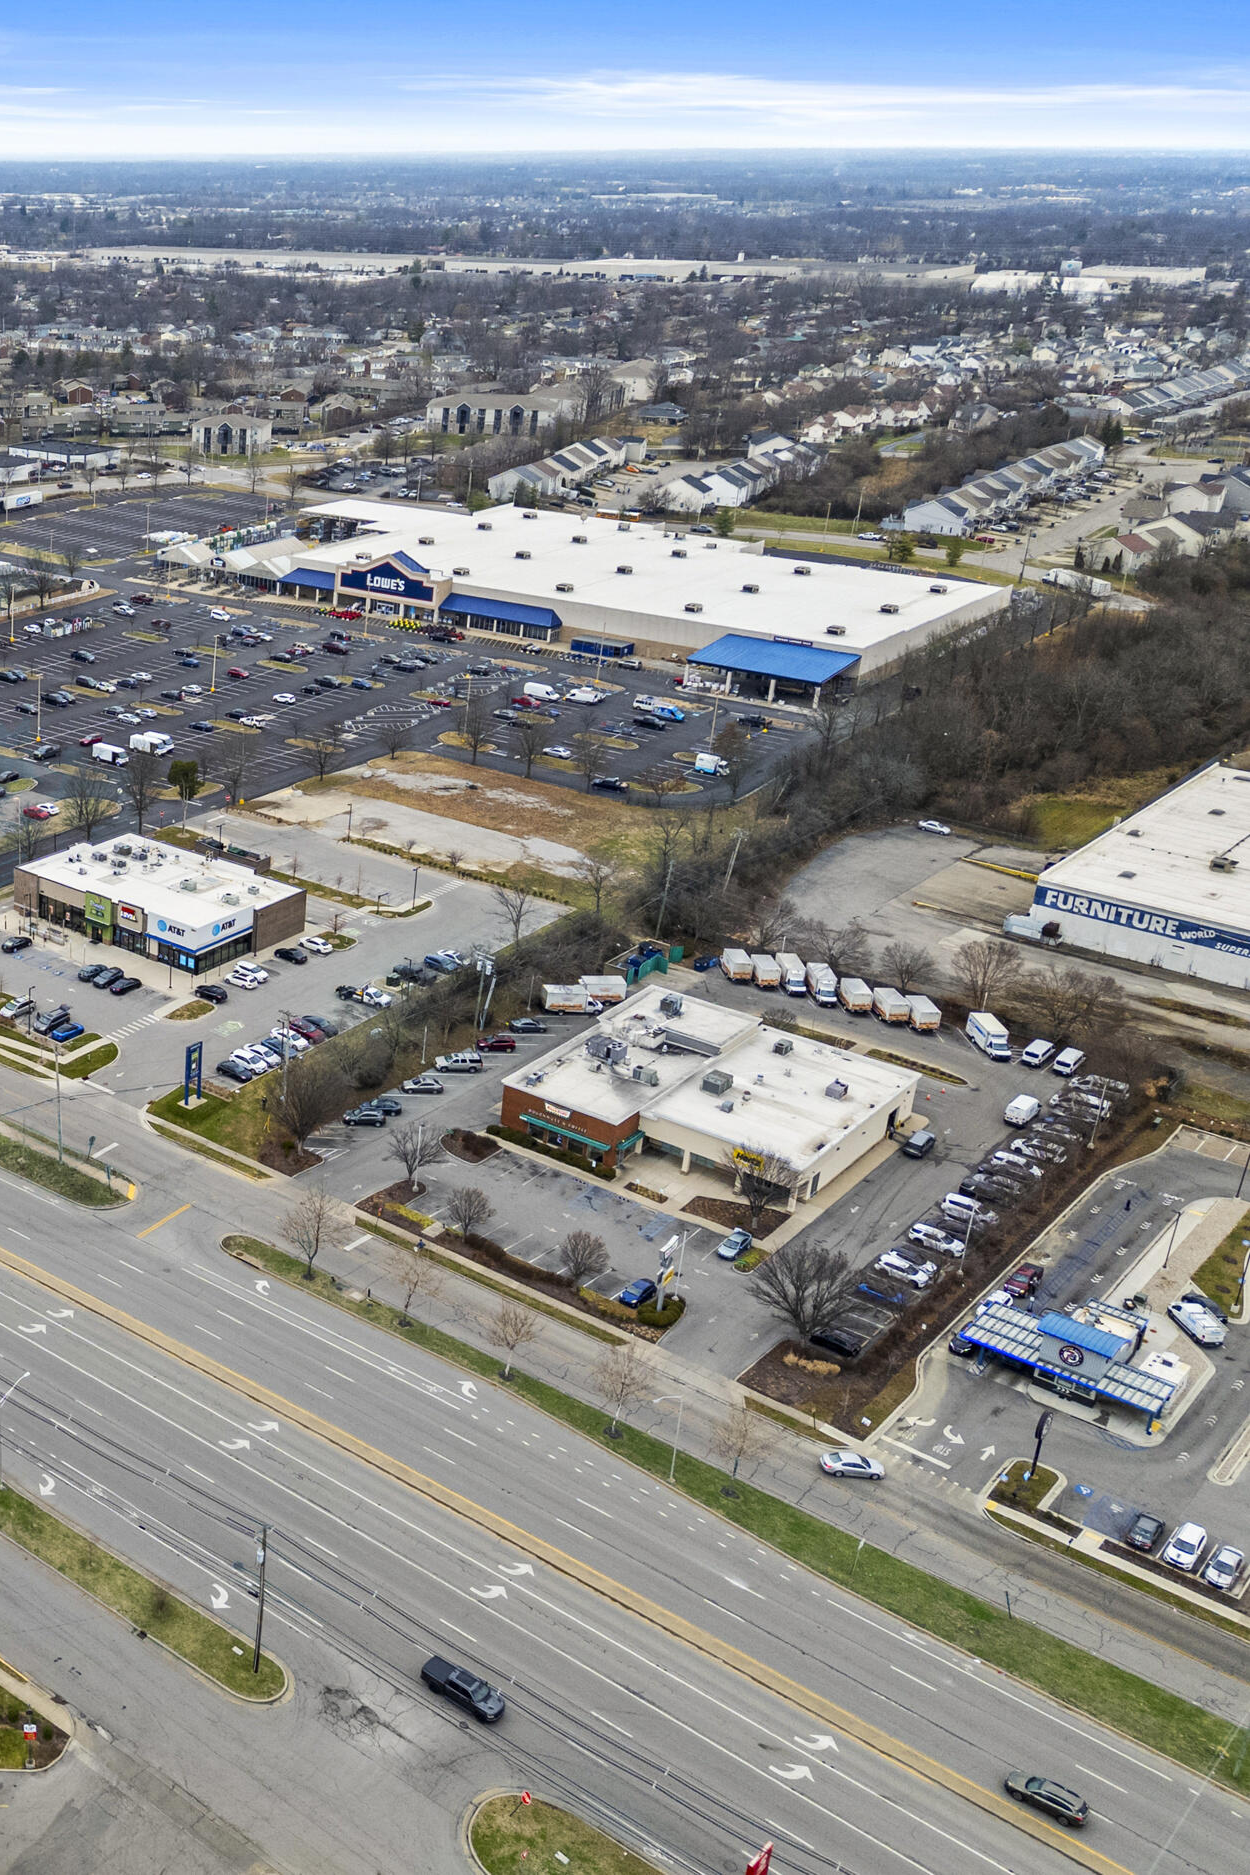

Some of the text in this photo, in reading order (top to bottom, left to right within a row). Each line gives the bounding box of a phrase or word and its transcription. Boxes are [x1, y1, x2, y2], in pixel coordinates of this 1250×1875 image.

[366, 573, 406, 592] LOWE'S
[1045, 890, 1179, 937] FURNITURE
[167, 924, 186, 937] AT&T
[220, 918, 237, 932] AT&T
[1180, 929, 1216, 940] WORLD
